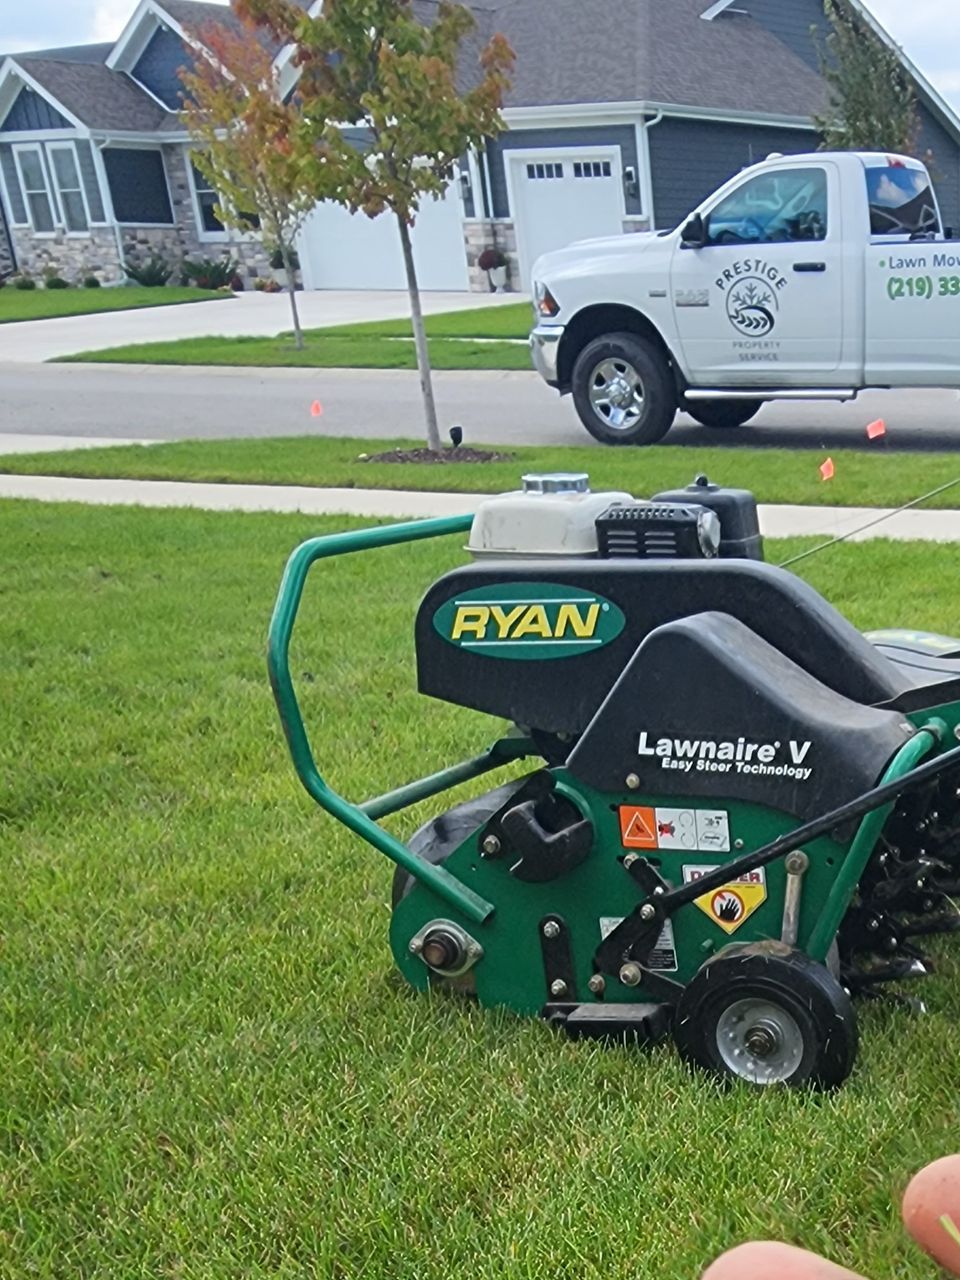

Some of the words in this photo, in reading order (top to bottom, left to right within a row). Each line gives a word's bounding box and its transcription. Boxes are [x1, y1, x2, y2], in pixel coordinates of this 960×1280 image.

[889, 255, 926, 269] Lawn
[715, 259, 788, 290] PRESTIGE
[887, 275, 933, 300] (219)
[732, 341, 781, 350] PROPERTY
[738, 352, 779, 362] SERVICE
[451, 603, 600, 640] RYAN
[638, 731, 776, 763] Lawnaire
[789, 740, 812, 764] V
[661, 757, 693, 772] Easy
[696, 759, 733, 773] Steer
[735, 761, 812, 780] Technology
